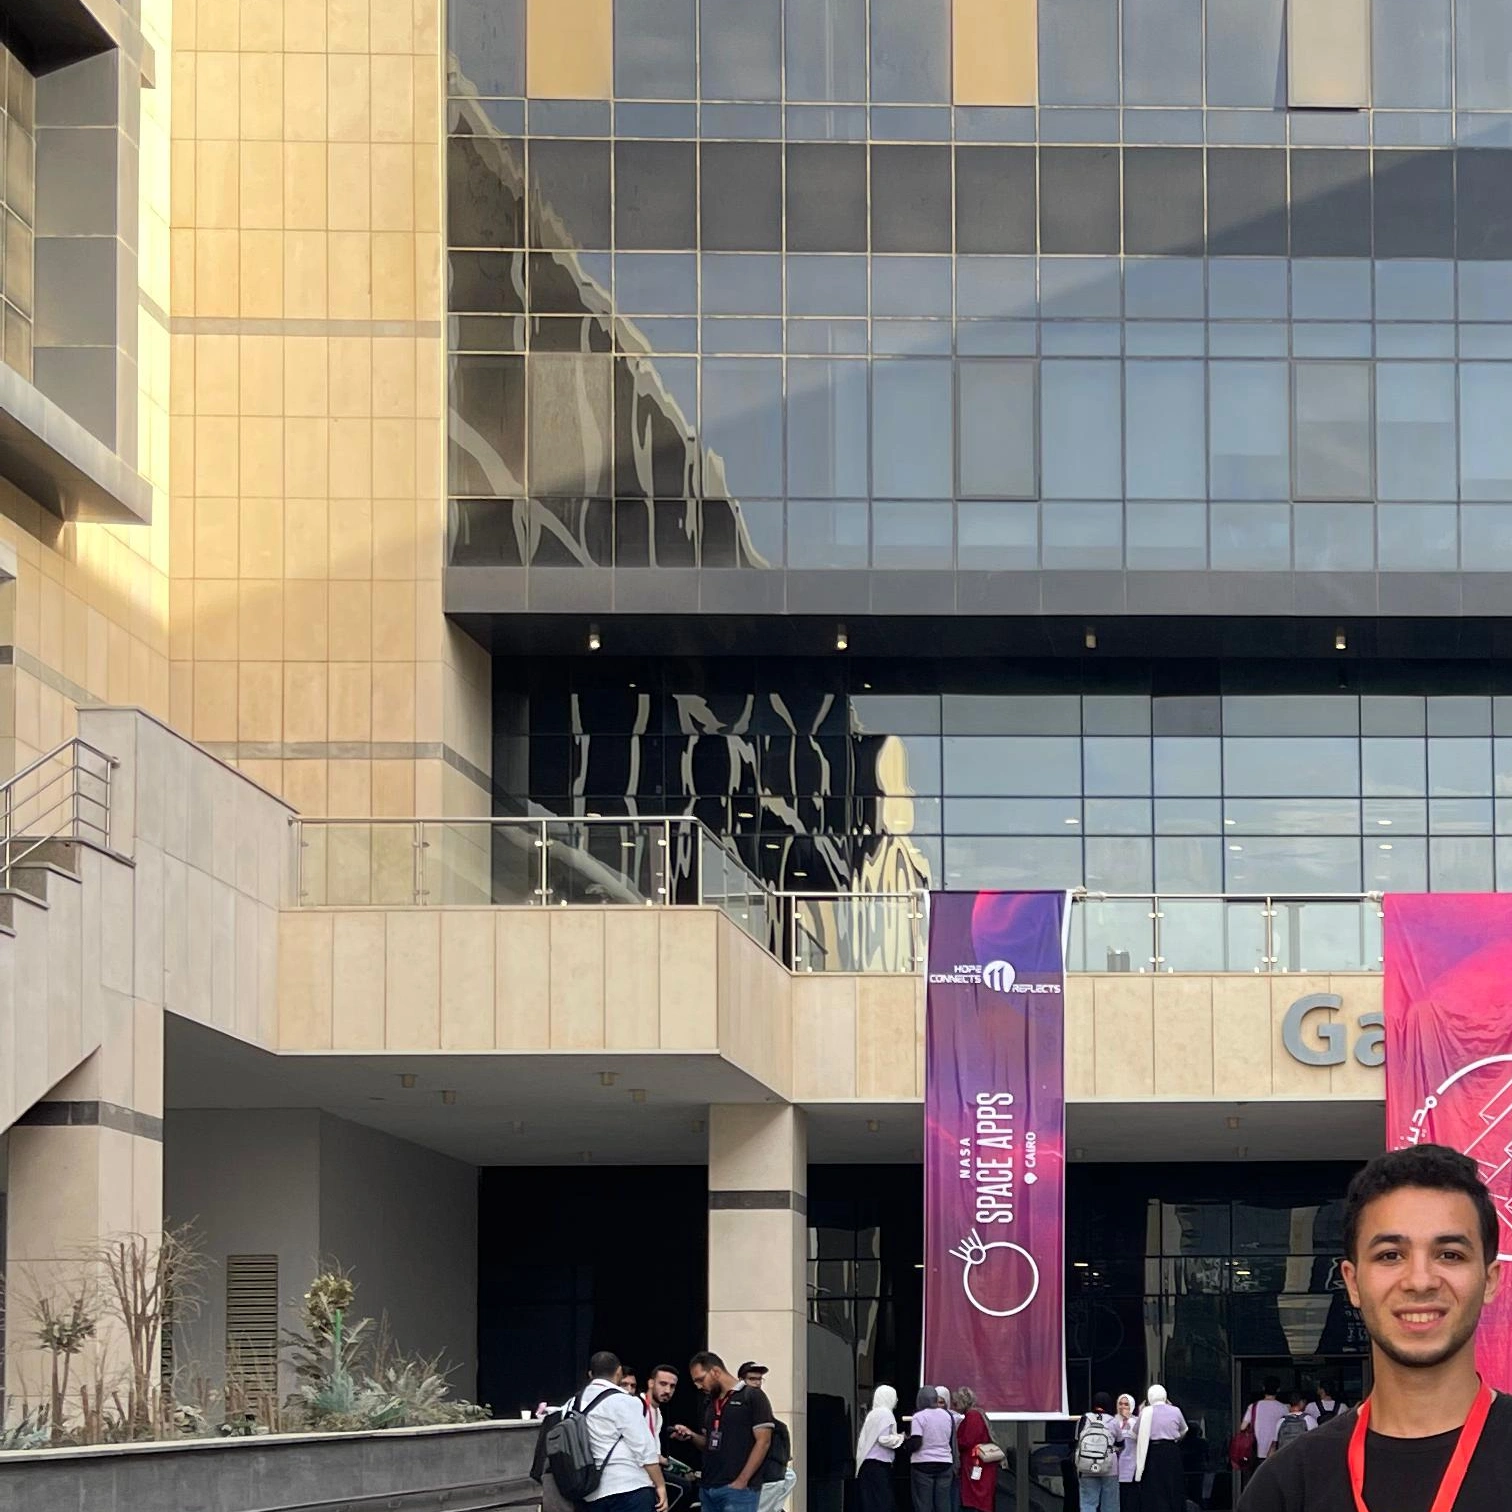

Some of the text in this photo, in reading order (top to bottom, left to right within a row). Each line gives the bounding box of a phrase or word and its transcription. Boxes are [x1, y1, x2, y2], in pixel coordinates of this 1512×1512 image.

[930, 974, 982, 984] CONNECTS
[954, 964, 982, 974] HOPE
[1012, 984, 1061, 994] REFLECTS
[960, 1137, 971, 1179] NASA
[975, 1092, 1014, 1223] SPACE APPS
[1025, 1131, 1037, 1168] CAIRO
